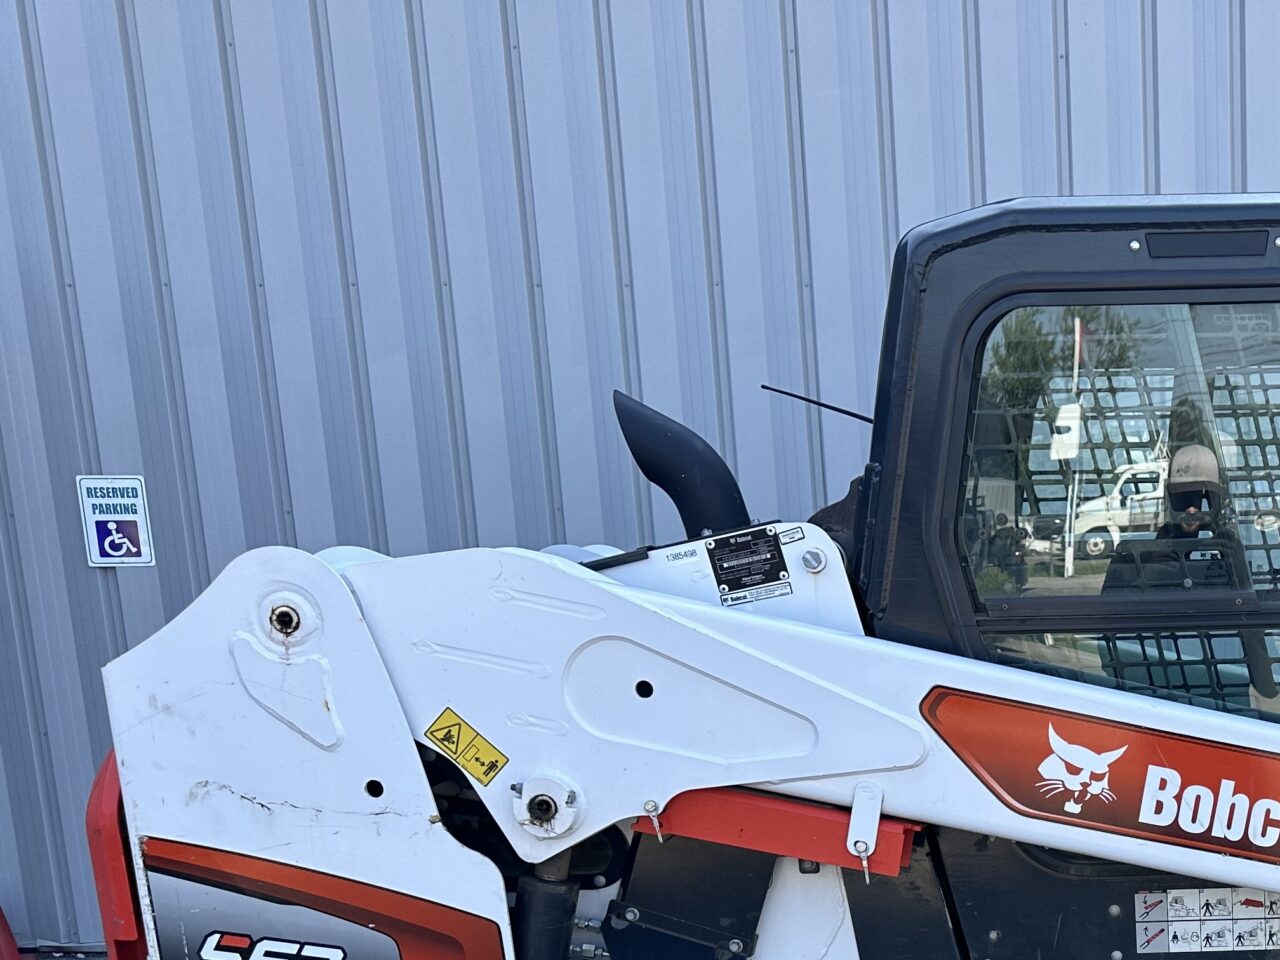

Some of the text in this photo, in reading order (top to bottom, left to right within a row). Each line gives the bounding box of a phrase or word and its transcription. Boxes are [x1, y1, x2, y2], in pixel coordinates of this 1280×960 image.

[86, 487, 138, 498] RESERVED
[91, 503, 138, 515] PARKING
[665, 548, 698, 562] 1385498
